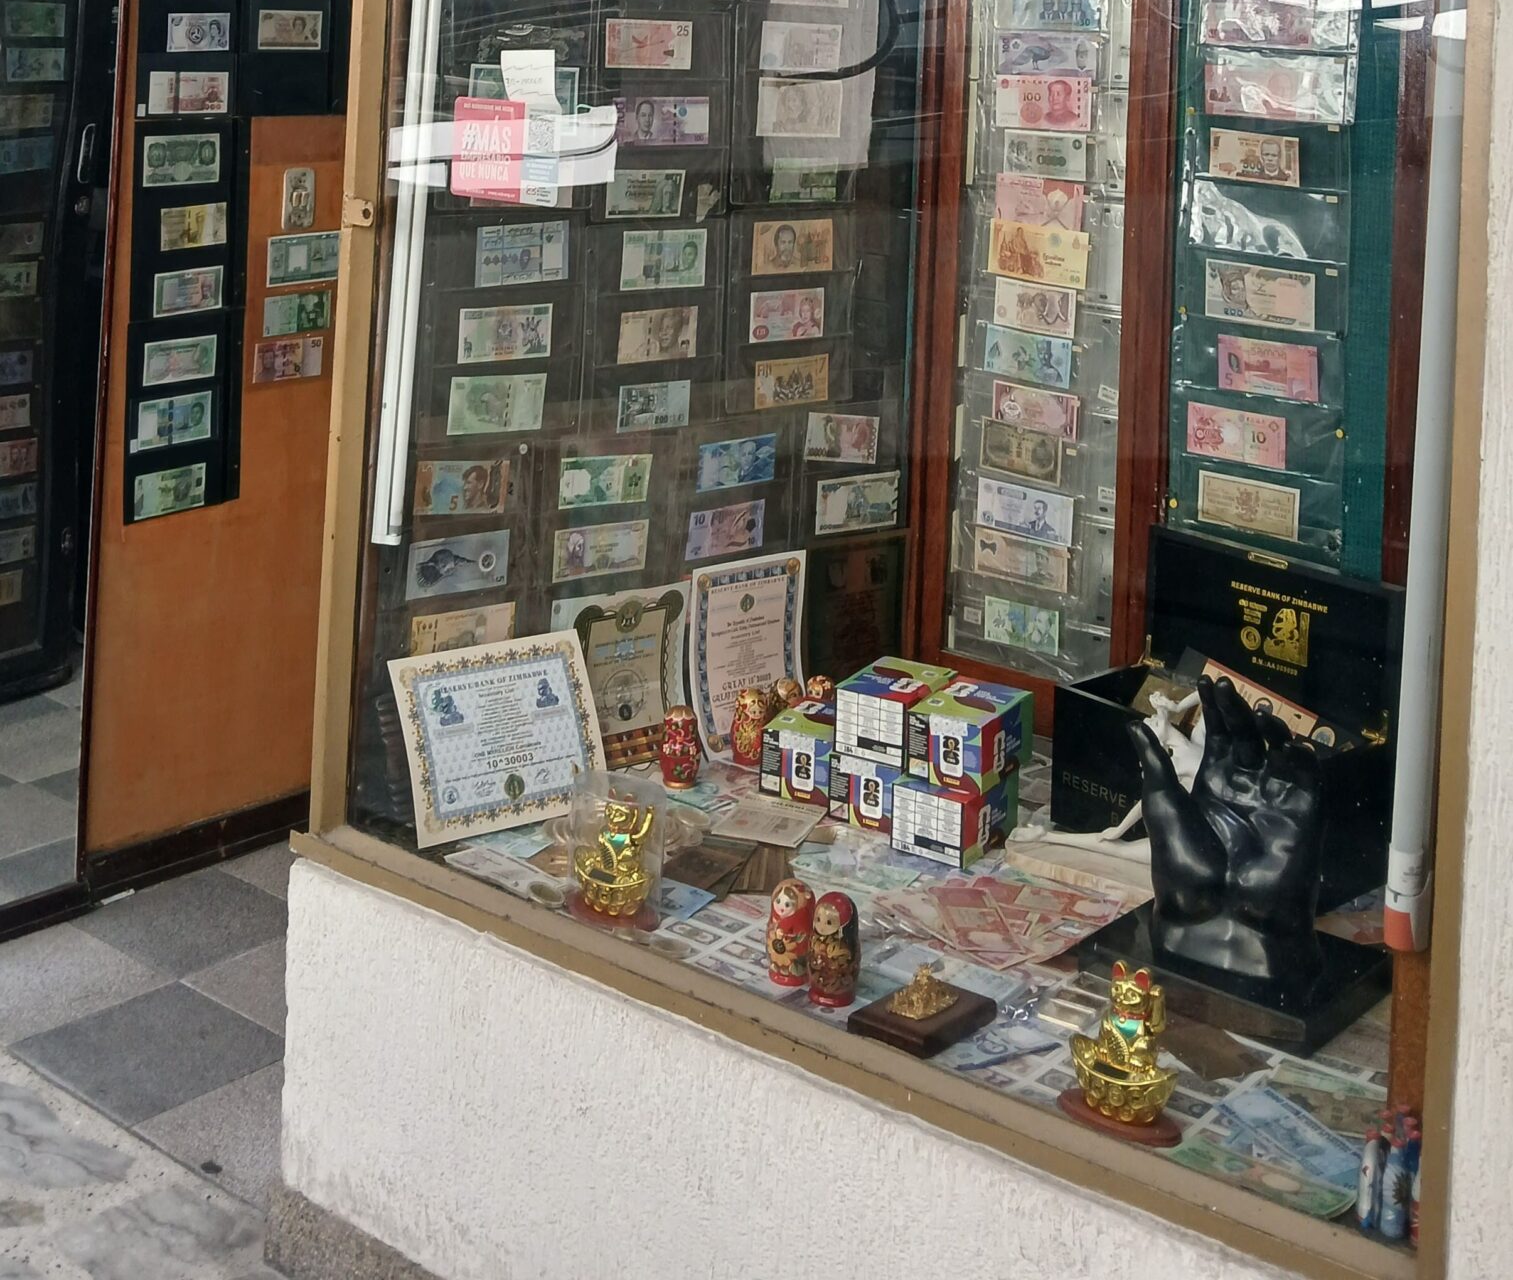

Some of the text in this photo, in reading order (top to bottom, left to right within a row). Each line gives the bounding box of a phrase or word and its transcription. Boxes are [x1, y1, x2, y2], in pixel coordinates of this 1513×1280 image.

[676, 25, 690, 37] 25
[1023, 92, 1041, 101] 100
[462, 115, 512, 154] #MÁS
[460, 162, 475, 178] QUE
[478, 163, 509, 182] NUNCA
[311, 339, 322, 349] 50
[1251, 431, 1266, 444] 10
[449, 495, 459, 511] 5
[693, 513, 705, 525] 10
[1231, 580, 1329, 614] RESERVE BANK OF ZIMBABWE
[1062, 771, 1127, 808] RESERVE
